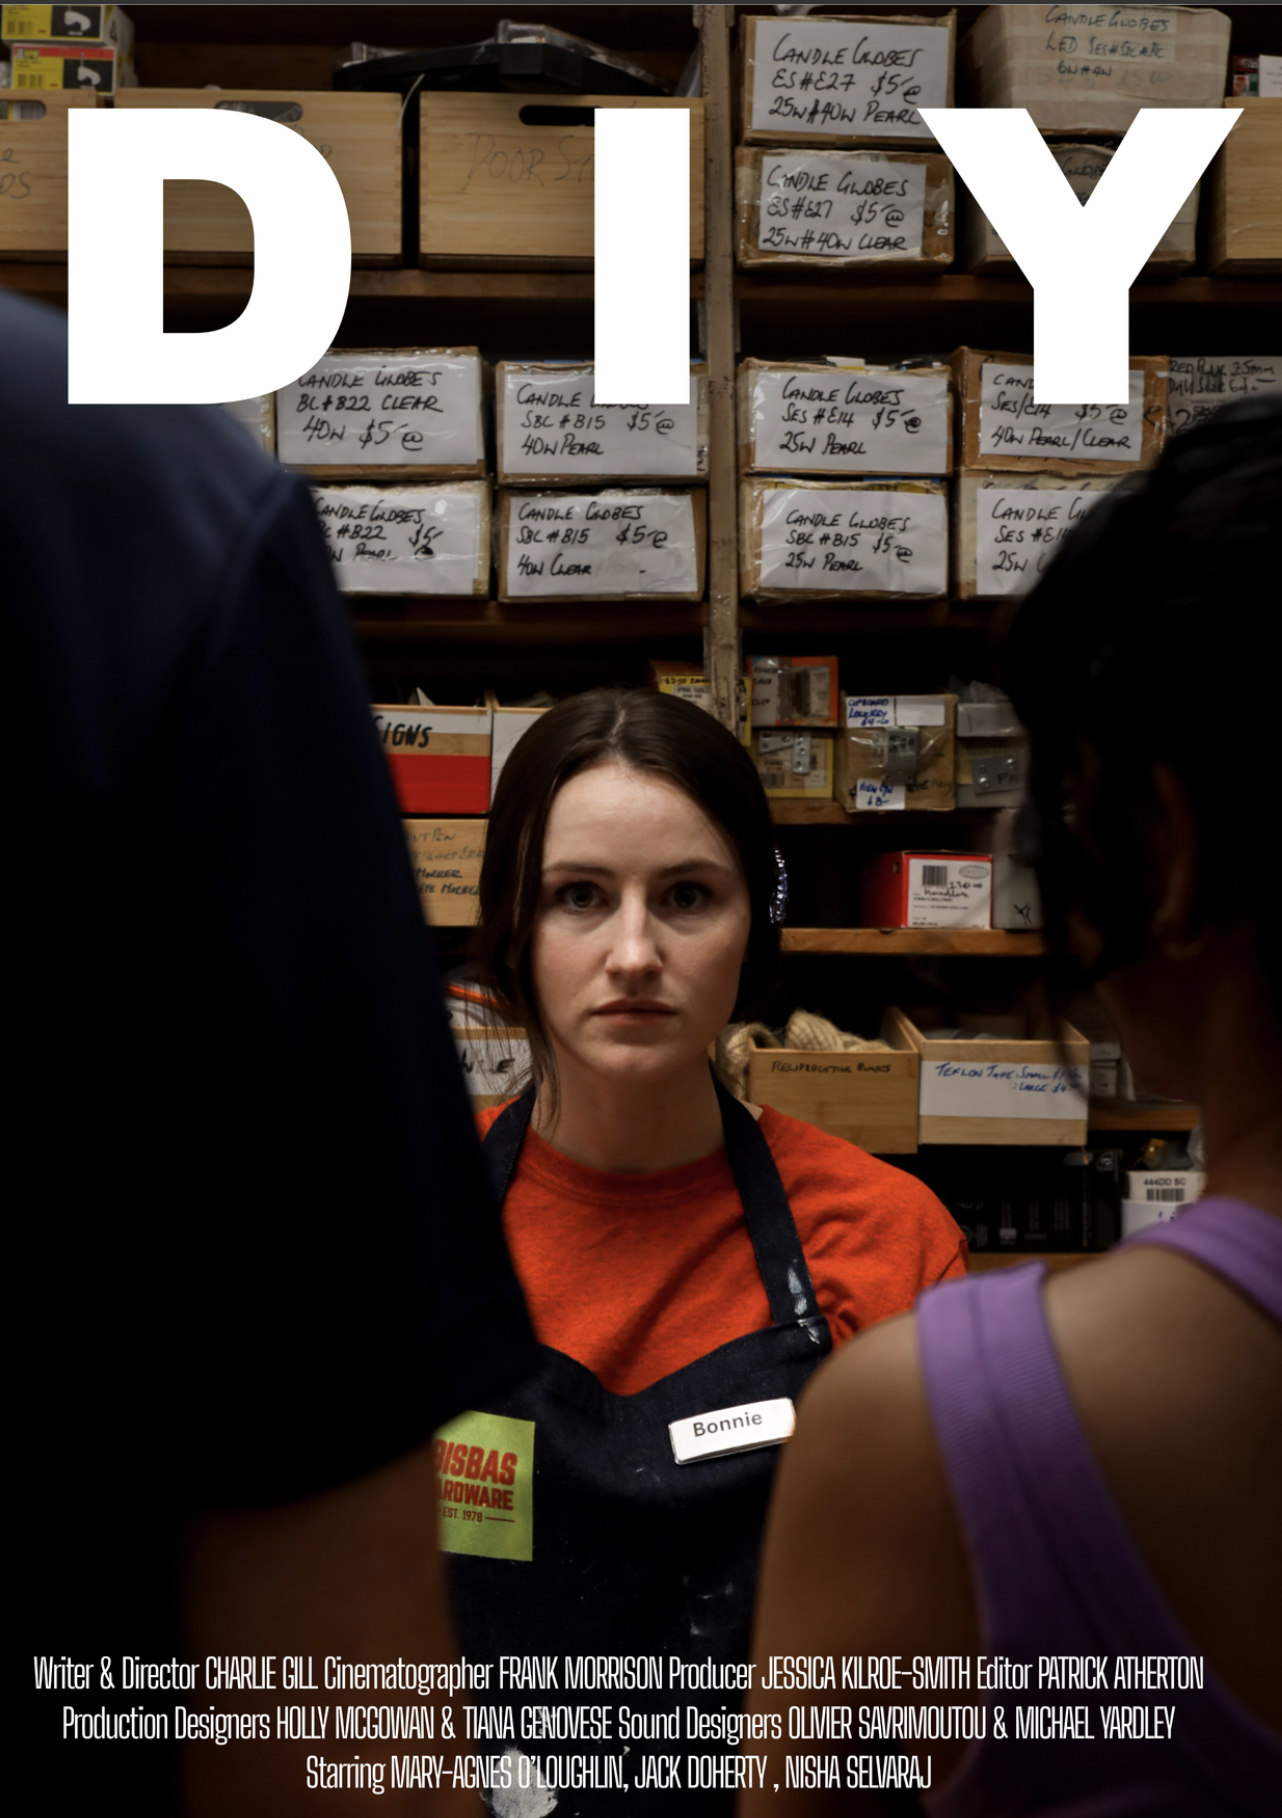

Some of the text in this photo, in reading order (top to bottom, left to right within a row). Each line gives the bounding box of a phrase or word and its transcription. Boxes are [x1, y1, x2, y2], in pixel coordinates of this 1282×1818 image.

[1046, 5, 1170, 32] CANDLE GLOBES
[773, 33, 924, 67] CANDLE GLOBES
[1046, 30, 1078, 54] LED
[863, 100, 922, 124] PEARL
[836, 171, 909, 196] GLOBES
[858, 234, 908, 251] CLEAR
[375, 365, 442, 387] GLOBES
[516, 383, 582, 408] CANDLE
[782, 376, 906, 406] CANDLE GLOBES
[381, 395, 444, 413] CLEAR
[782, 402, 808, 424] SES
[520, 410, 554, 429] SBC
[560, 432, 604, 456] PEARL
[822, 432, 868, 456] PEARL
[369, 499, 426, 524] GLOBES
[518, 501, 644, 521] CANDLE GLOBES
[992, 497, 1062, 520] CANDLE
[786, 509, 911, 532] CANDLE GLOBES
[786, 529, 814, 546] SBC
[994, 525, 1025, 543] SES
[550, 553, 592, 576] CLEAR
[822, 552, 864, 572] PEARL
[935, 1062, 983, 1078] TEFLON
[692, 1411, 764, 1438] Bonnie
[436, 1478, 514, 1511] ARDWARE
[462, 1510, 482, 1522] 1978
